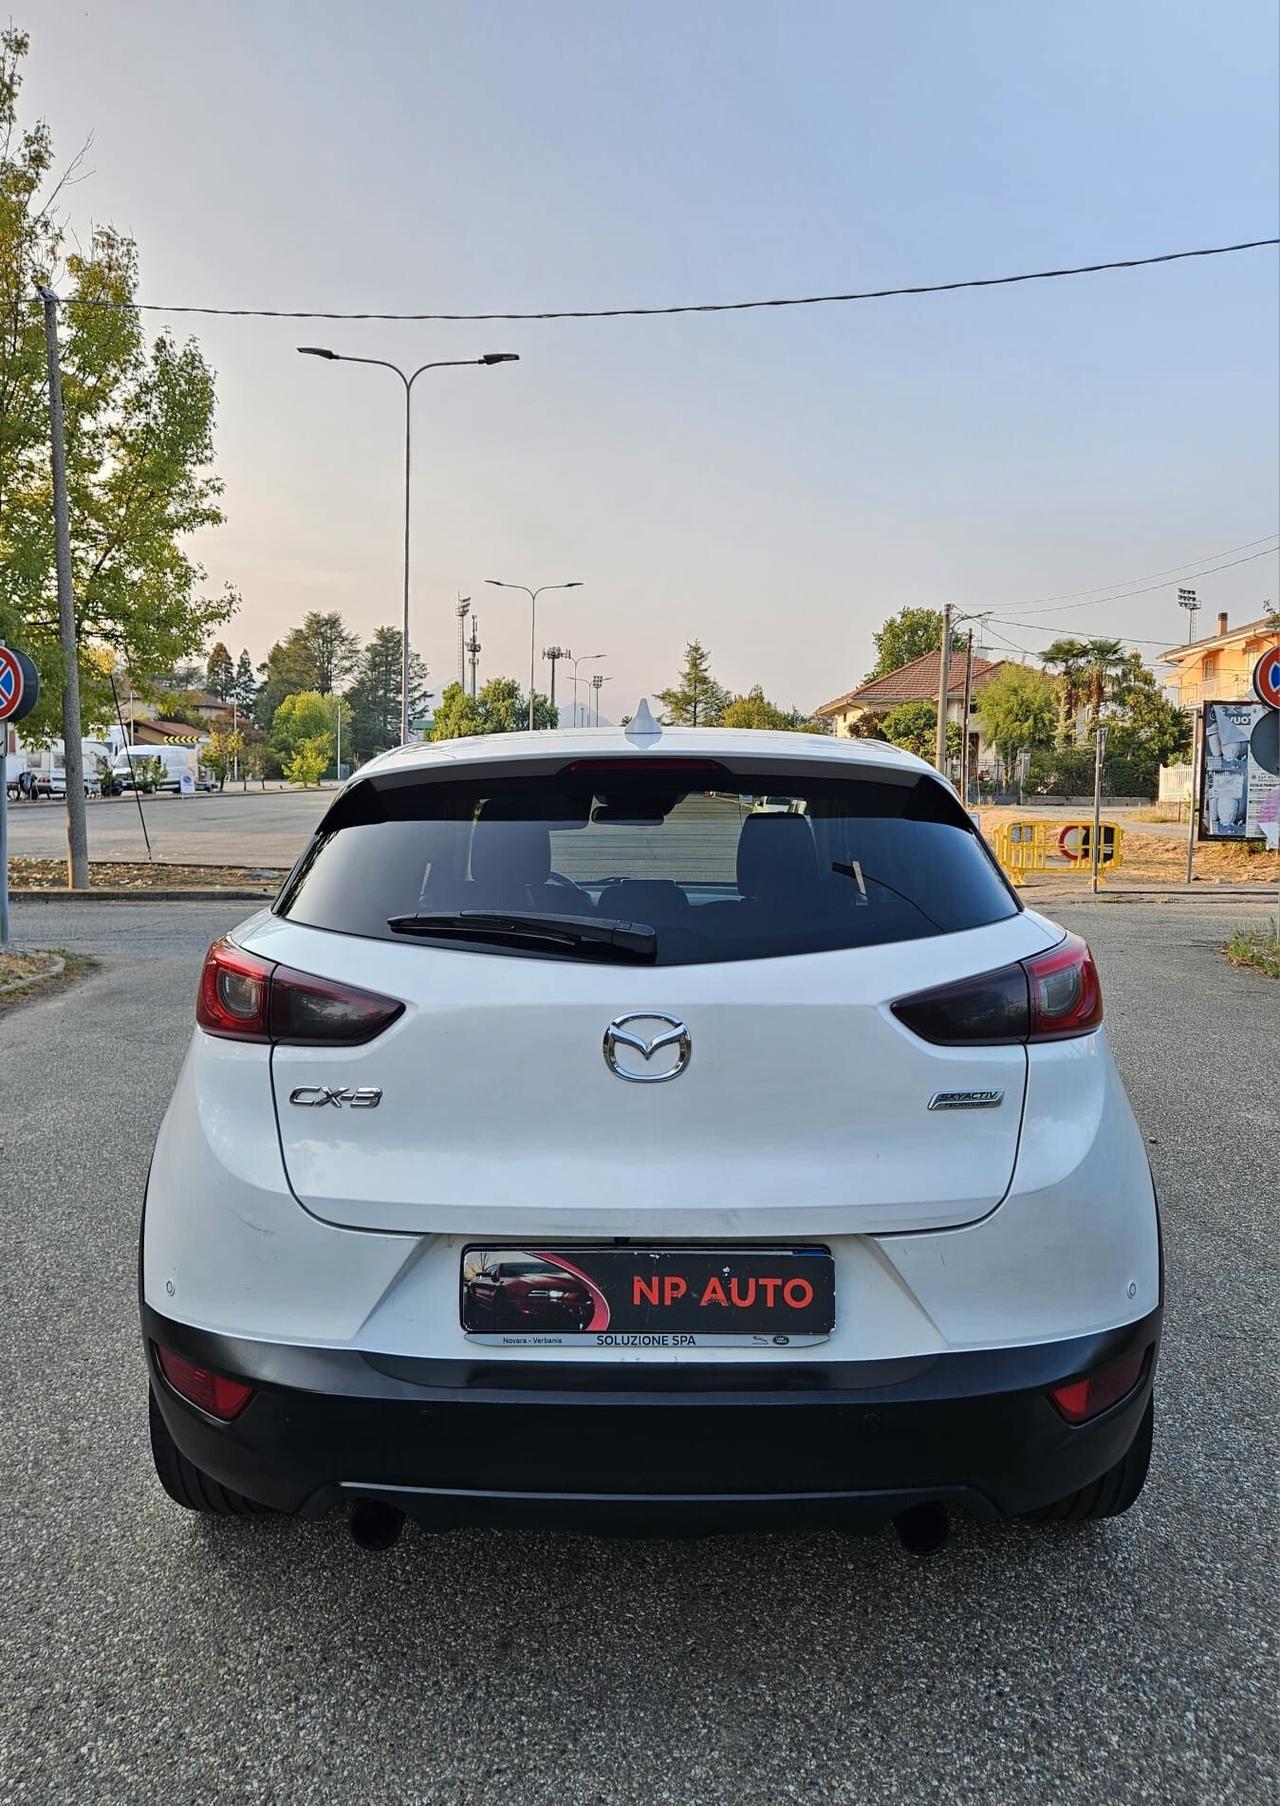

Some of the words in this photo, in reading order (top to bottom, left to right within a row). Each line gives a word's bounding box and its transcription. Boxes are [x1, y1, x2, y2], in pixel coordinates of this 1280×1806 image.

[289, 1086, 383, 1108] CX-3
[941, 1092, 998, 1101] SKYACTIV
[632, 1275, 687, 1307] NP
[700, 1276, 814, 1309] AUTO
[503, 1337, 528, 1345] Novara
[533, 1337, 563, 1345] Verbania
[596, 1335, 669, 1346] SOLUZIONE
[672, 1335, 697, 1346] SPA
